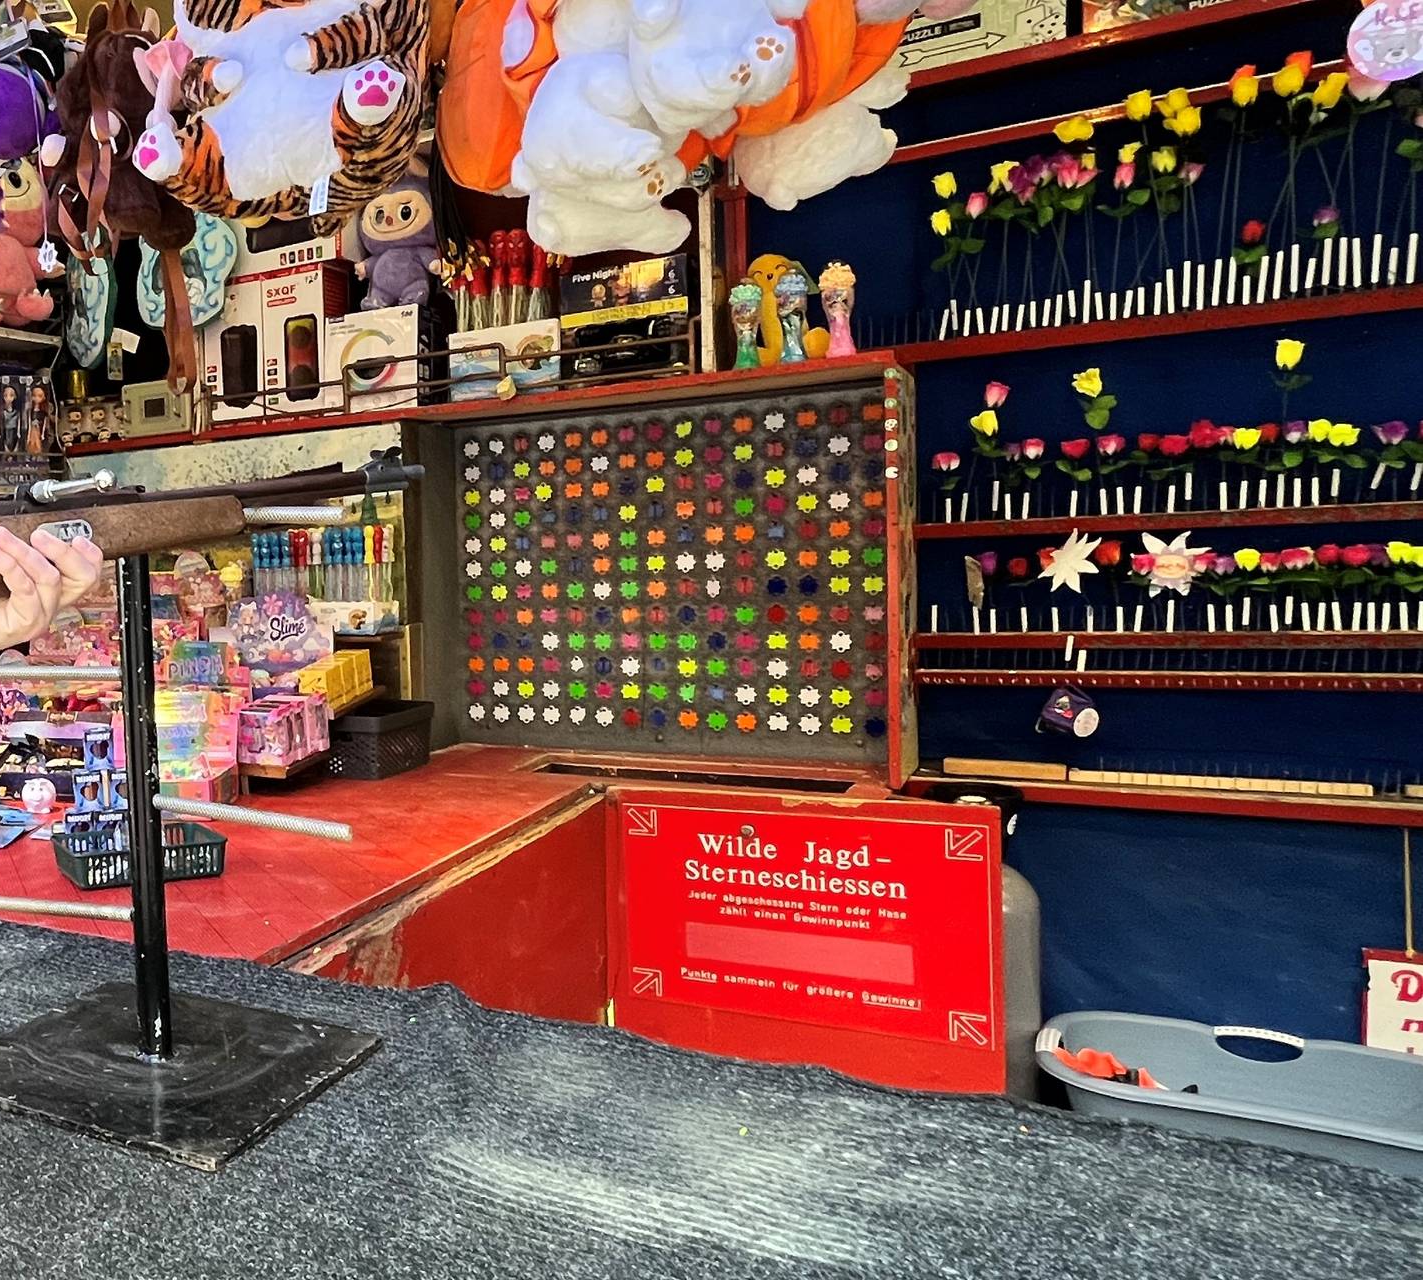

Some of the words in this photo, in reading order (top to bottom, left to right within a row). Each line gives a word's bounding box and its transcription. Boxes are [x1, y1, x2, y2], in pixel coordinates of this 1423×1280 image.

[266, 283, 297, 299] SXQF
[572, 274, 591, 283] Five
[270, 616, 306, 641] Slime
[697, 833, 777, 860] Wilde
[684, 859, 907, 900] Sterneschiessen
[688, 890, 717, 901] Jeder
[809, 901, 839, 913] Stern
[845, 906, 871, 916] oder
[878, 908, 907, 920] Hase
[719, 906, 747, 917] zählt
[754, 909, 786, 921] einen
[793, 912, 871, 930] Gewinnpunkt
[680, 966, 717, 983] Punkte
[724, 975, 776, 988] sammeln
[782, 980, 799, 992] für
